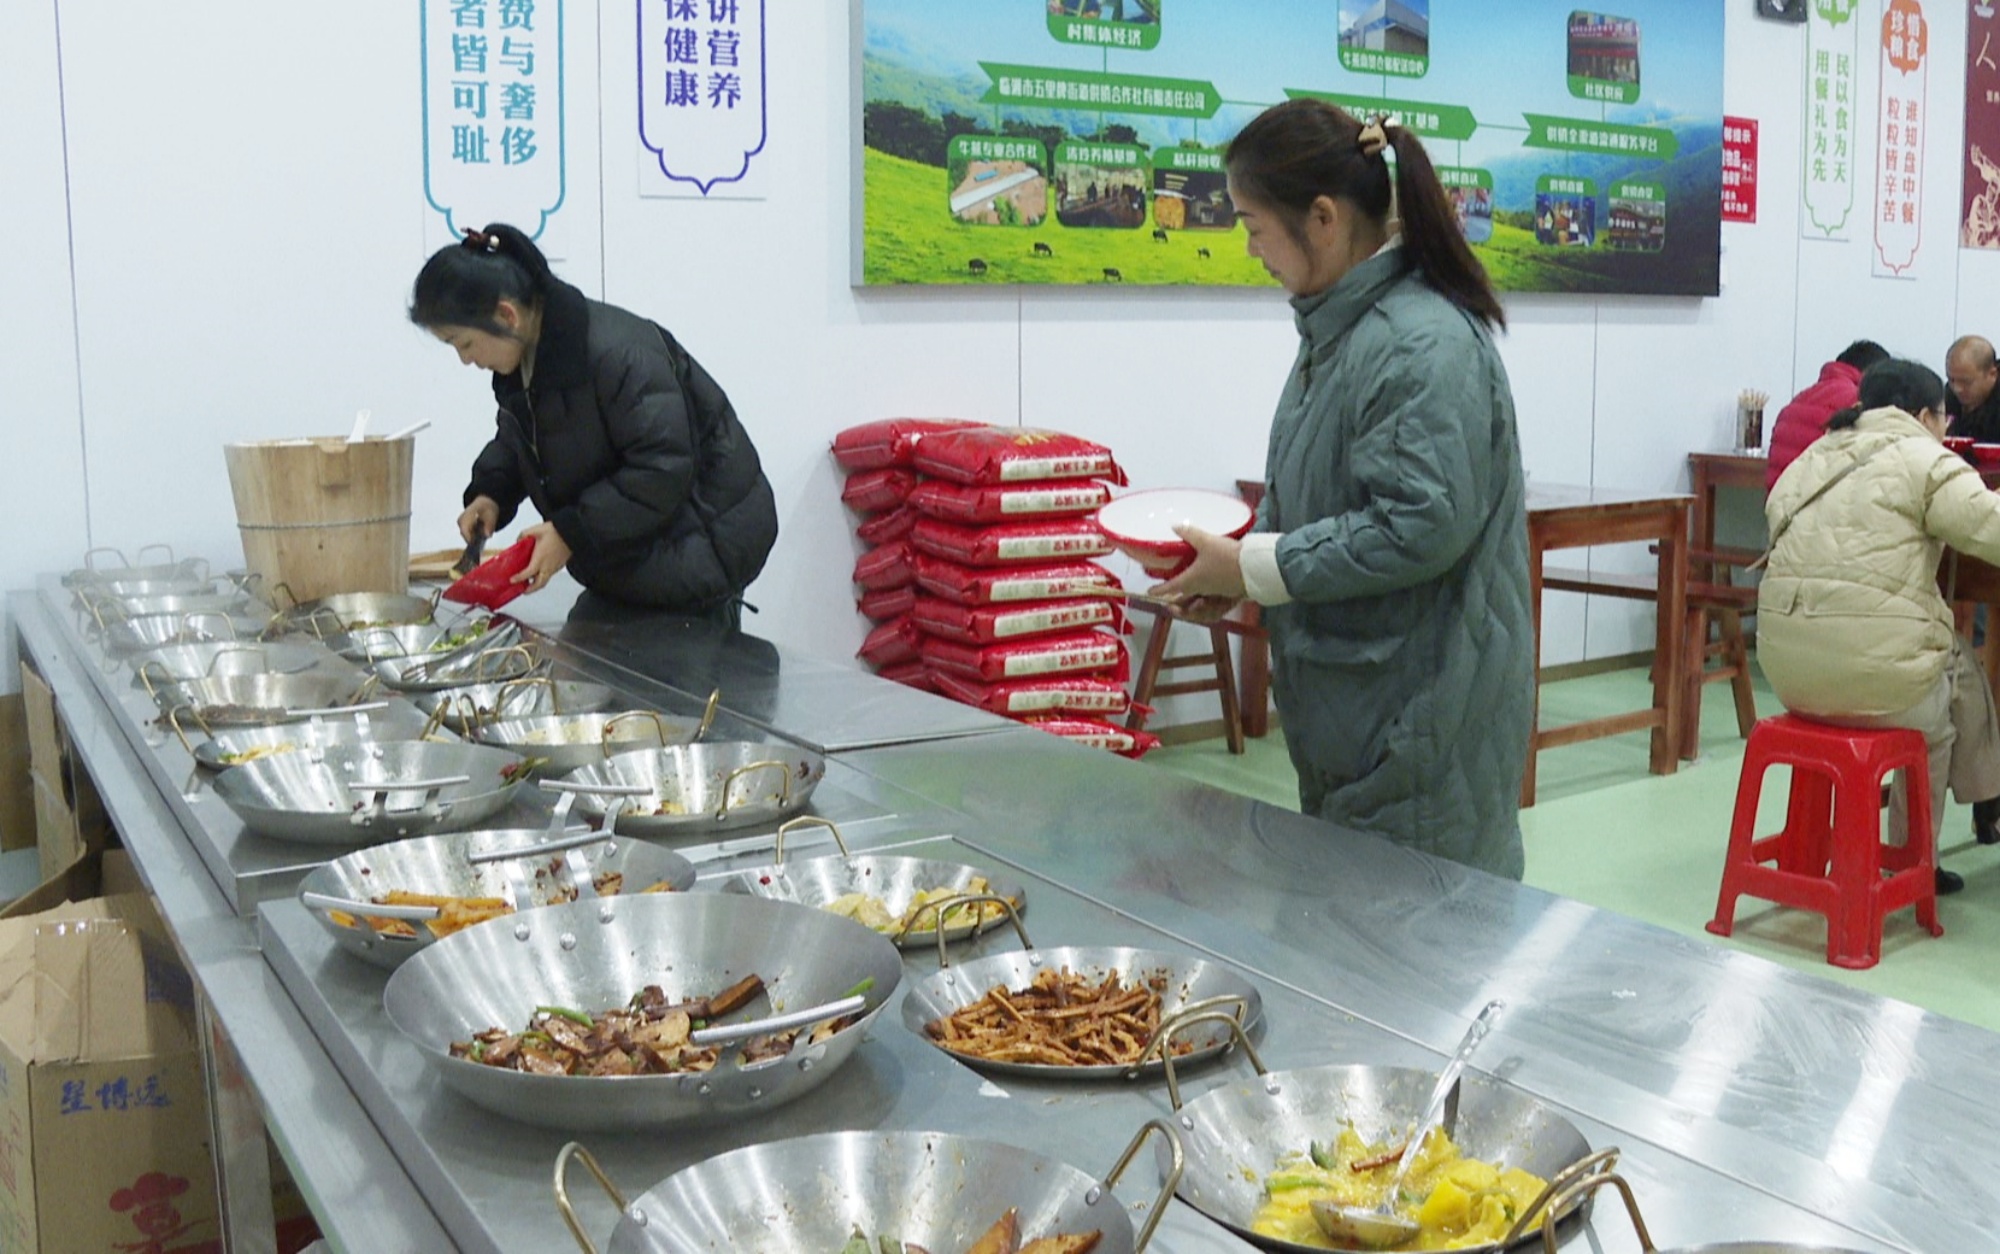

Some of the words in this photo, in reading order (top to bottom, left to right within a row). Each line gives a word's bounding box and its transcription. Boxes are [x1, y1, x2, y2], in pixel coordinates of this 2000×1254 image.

[451, 0, 491, 165] 者皆可耻
[498, 0, 537, 165] 费与奢侈
[664, 0, 699, 107] 保健康
[707, 0, 741, 109] 讲营养
[1066, 23, 1142, 47] 村集体经济
[1813, 49, 1829, 182] 用餐礼为先
[1833, 53, 1849, 183] 民以食为天
[1883, 97, 1900, 223] 粒粒皆辛苦
[1902, 100, 1918, 224] 谁知盘中餐
